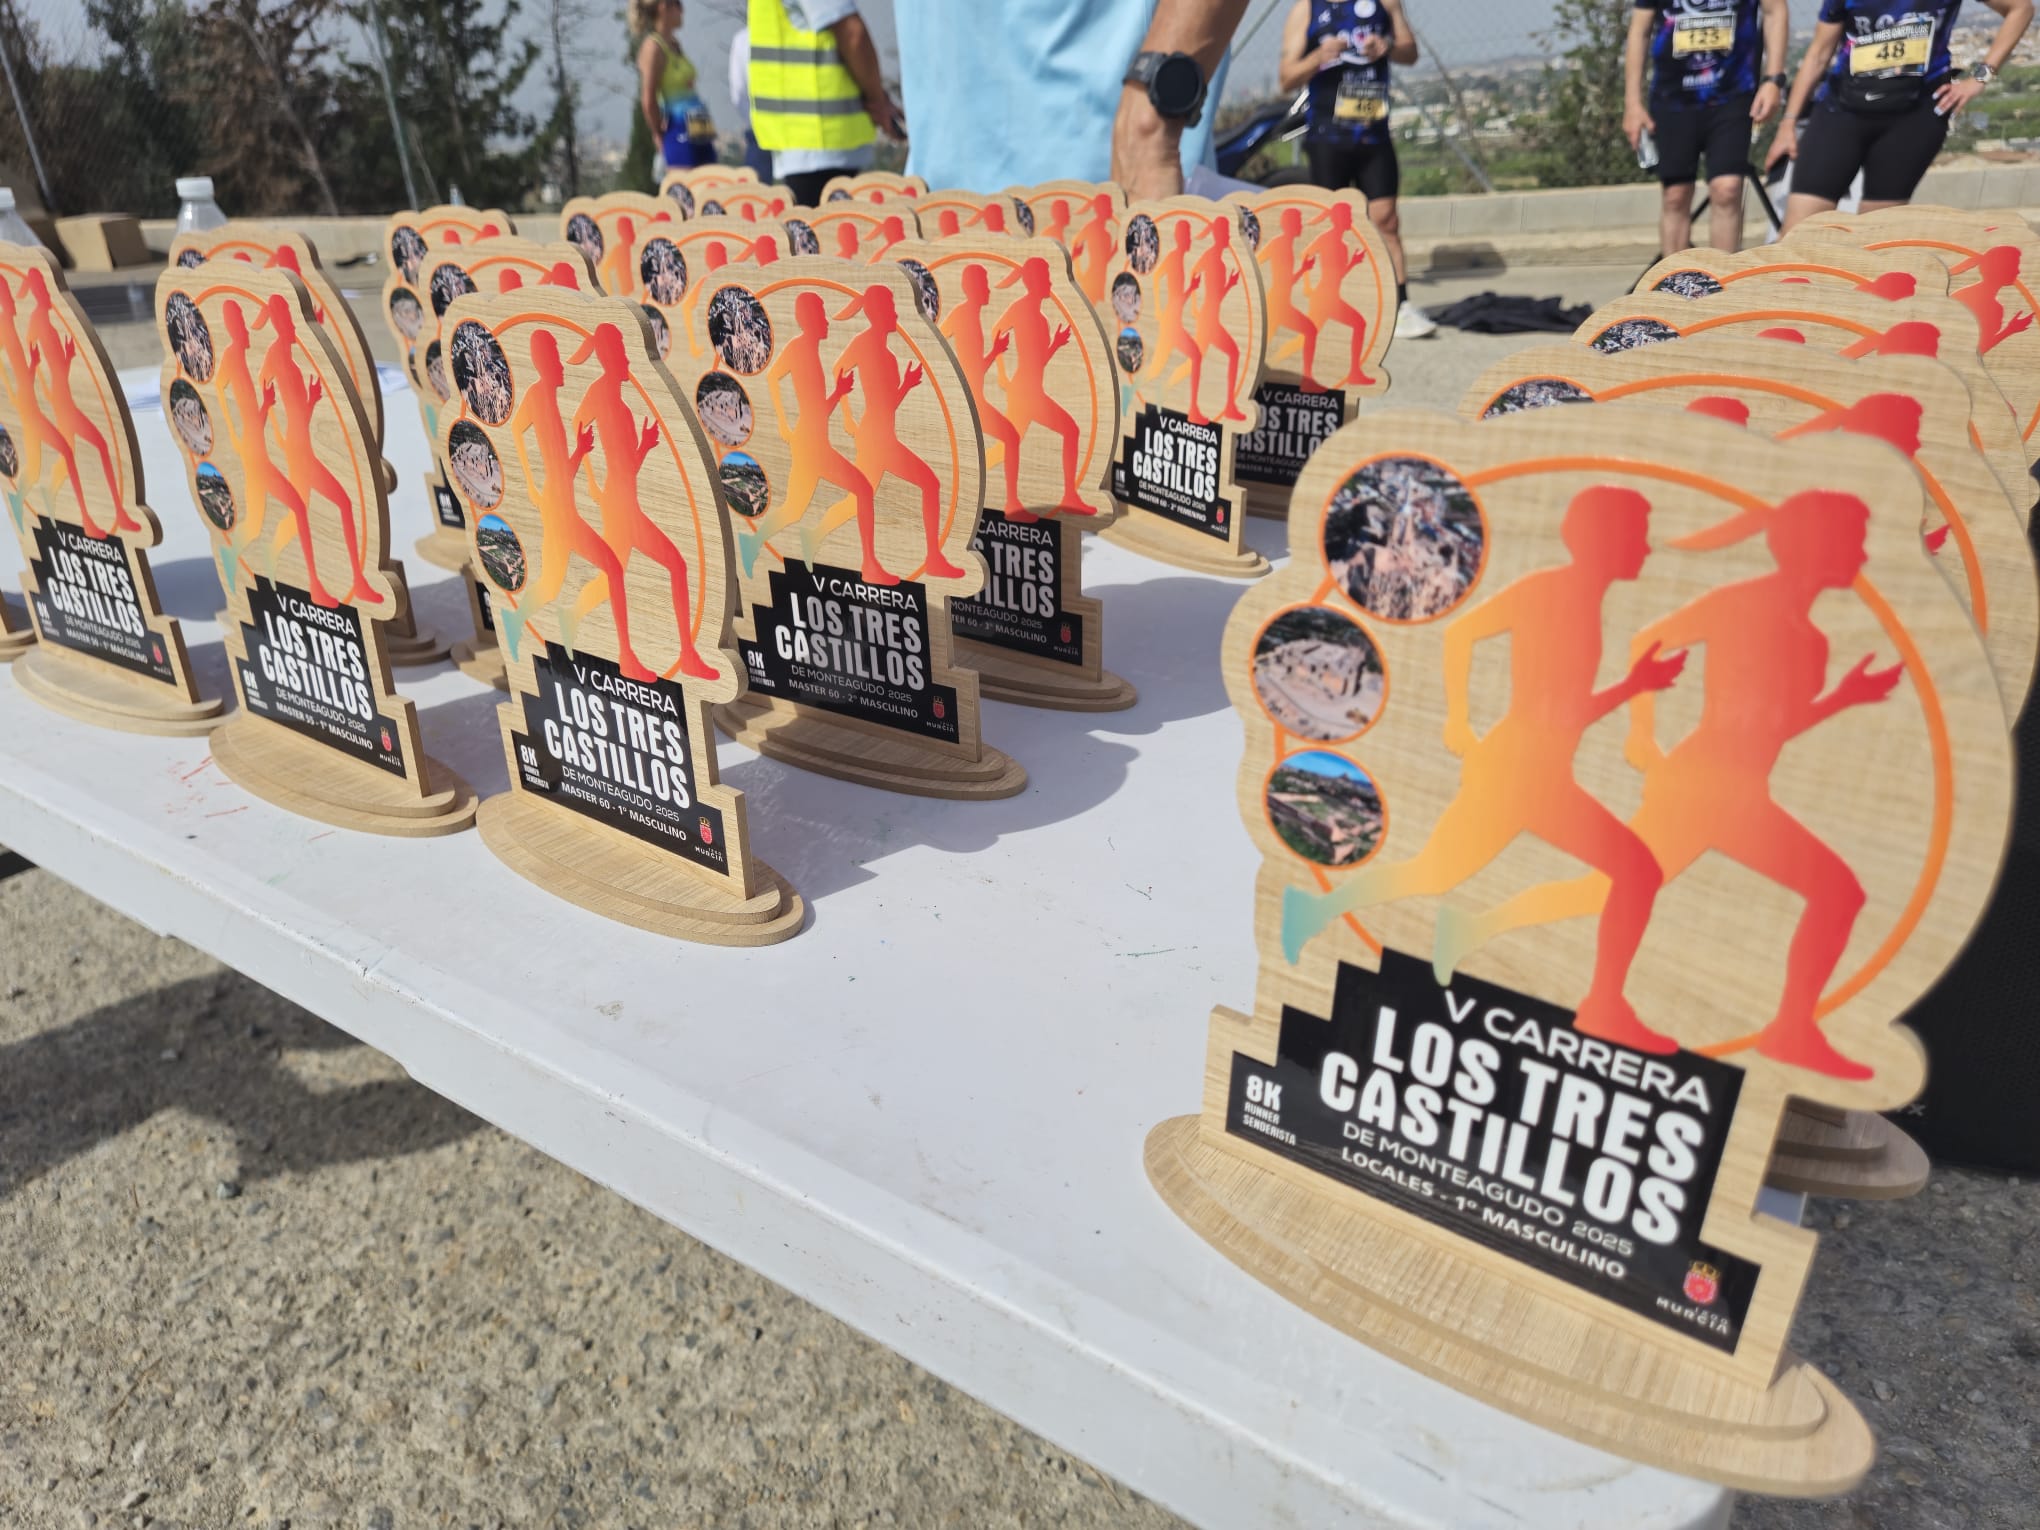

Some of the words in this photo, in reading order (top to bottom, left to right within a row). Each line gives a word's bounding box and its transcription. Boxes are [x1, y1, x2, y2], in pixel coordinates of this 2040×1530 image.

[1876, 41, 1906, 60] 48
[1262, 390, 1272, 402] V
[1274, 391, 1339, 410] CARRERA
[1145, 427, 1174, 461] LOS
[1177, 437, 1217, 475] TRES
[1160, 415, 1168, 429] V
[1168, 419, 1218, 445] CARRERA
[1235, 430, 1323, 459] ASTILLO
[1132, 451, 1216, 503] CASTILLOS
[57, 531, 66, 547] V
[69, 535, 124, 563] CARRERA
[977, 519, 1053, 547] CARRERA
[49, 546, 87, 587] LOS
[84, 556, 135, 602] TRES
[991, 541, 1054, 584] TRES
[48, 577, 144, 638] CASTILLOS
[276, 593, 287, 612] V
[290, 599, 357, 638] CARRERA
[812, 575, 826, 592] V
[829, 580, 919, 612] CARRERA
[974, 575, 1054, 618] ILLOS
[264, 610, 307, 660] LOS
[306, 626, 365, 681] TRES
[790, 592, 844, 637] LOS
[849, 603, 922, 654] TRES
[951, 614, 966, 625] TER
[995, 625, 1047, 644] MASCULINO
[747, 650, 764, 669] 8K
[775, 624, 925, 691] CASTILLOS
[259, 644, 373, 721] CASTILLOS
[573, 664, 586, 685] V
[591, 670, 678, 717] CARRERA
[789, 679, 826, 696] MASTER
[828, 688, 840, 699] 60
[860, 696, 918, 719] MASCULINO
[791, 665, 807, 676] DE
[807, 668, 885, 696] MONTEAGUDO
[888, 689, 912, 703] 2025
[276, 687, 288, 699] DE
[288, 690, 345, 724] MONTEAGUDO
[348, 717, 367, 733] 2025
[276, 702, 305, 722] MASTER
[305, 713, 315, 726] 55
[328, 724, 373, 750] MASCULINO
[555, 682, 608, 737] LOS
[610, 700, 684, 765] TRES
[520, 744, 538, 767] 8K
[544, 719, 690, 809] CASTILLOS
[561, 781, 597, 805] MASTER
[599, 796, 610, 810] 60
[629, 808, 687, 841] MASCULINO
[562, 765, 577, 780] DE
[578, 768, 652, 810] MONTEAGUDO
[656, 804, 680, 822] 2025
[1444, 990, 1476, 1024] V
[1483, 1006, 1712, 1114] CARRERA
[1244, 1101, 1281, 1125] RUNNER
[1246, 1074, 1282, 1112] 8K
[1371, 1005, 1502, 1106] LOS
[1519, 1056, 1705, 1183] TRES
[1242, 1113, 1297, 1147] SENDERISTA
[1318, 1050, 1687, 1246] CASTILLOS
[1343, 1121, 1375, 1149] DE
[1378, 1129, 1566, 1229] MONTEAGUDO
[1571, 1219, 1634, 1256] 2025
[1341, 1146, 1434, 1199] LOCALES
[1455, 1193, 1478, 1213] 1º
[1482, 1204, 1627, 1280] MASCULINO
[1656, 1297, 1729, 1336] MURCIA
